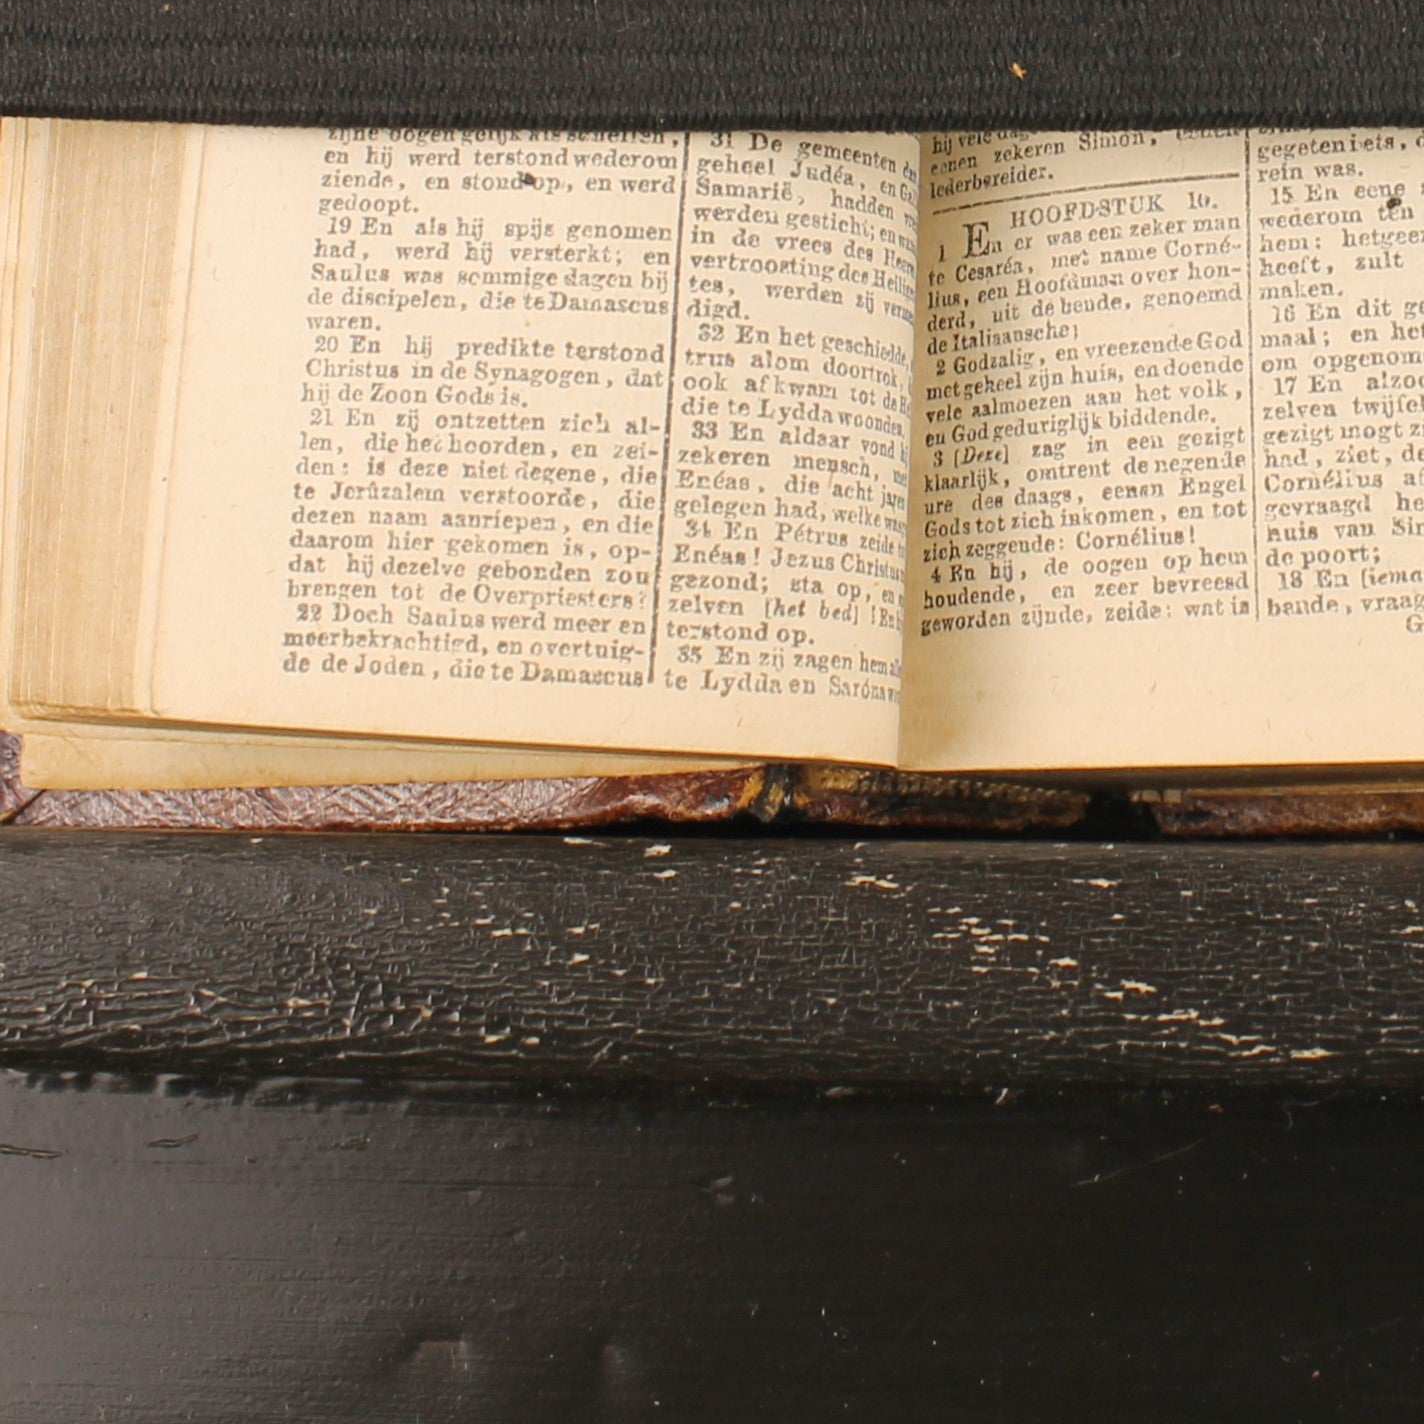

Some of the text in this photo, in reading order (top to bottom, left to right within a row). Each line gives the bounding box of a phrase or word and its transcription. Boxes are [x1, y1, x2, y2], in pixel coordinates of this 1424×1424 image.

[1009, 194, 1164, 231] HOOFDSTUK
[938, 244, 946, 263] 1
[961, 221, 1003, 259] En
[1014, 236, 1032, 251] er
[1087, 226, 1123, 242] een
[1130, 217, 1187, 237] zeker
[1193, 217, 1241, 233] man
[927, 340, 947, 354] de
[936, 358, 946, 377] 2
[1055, 347, 1079, 362] en
[1085, 334, 1193, 359] vreezende
[1196, 329, 1243, 350] God
[306, 358, 399, 379] Christus
[411, 361, 433, 379] in
[440, 362, 467, 380] de
[625, 369, 663, 388] dat
[1273, 376, 1297, 396] 17
[1308, 374, 1343, 393] En
[925, 404, 962, 425] vele
[971, 395, 1072, 419] aalmoezen
[1085, 391, 1121, 406] aan
[1135, 383, 1171, 402] het
[310, 408, 333, 426] 21
[345, 408, 375, 426] En
[396, 409, 419, 432] zij
[435, 412, 545, 431] ontzetten
[560, 412, 611, 433] zich
[729, 422, 765, 442] En
[779, 425, 850, 449] aldaar
[861, 439, 894, 459] vond
[677, 447, 770, 467] zekeren
[1264, 470, 1383, 493] Cornélius
[770, 546, 834, 571] Jezus
[1265, 547, 1293, 567] de
[1278, 570, 1303, 591] 18
[1315, 568, 1349, 588] En
[1406, 614, 1424, 633] G
[283, 653, 310, 673] de
[322, 655, 348, 673] de
[449, 658, 485, 679] die
[491, 662, 514, 681] te
[664, 668, 815, 698] te Lydda en
